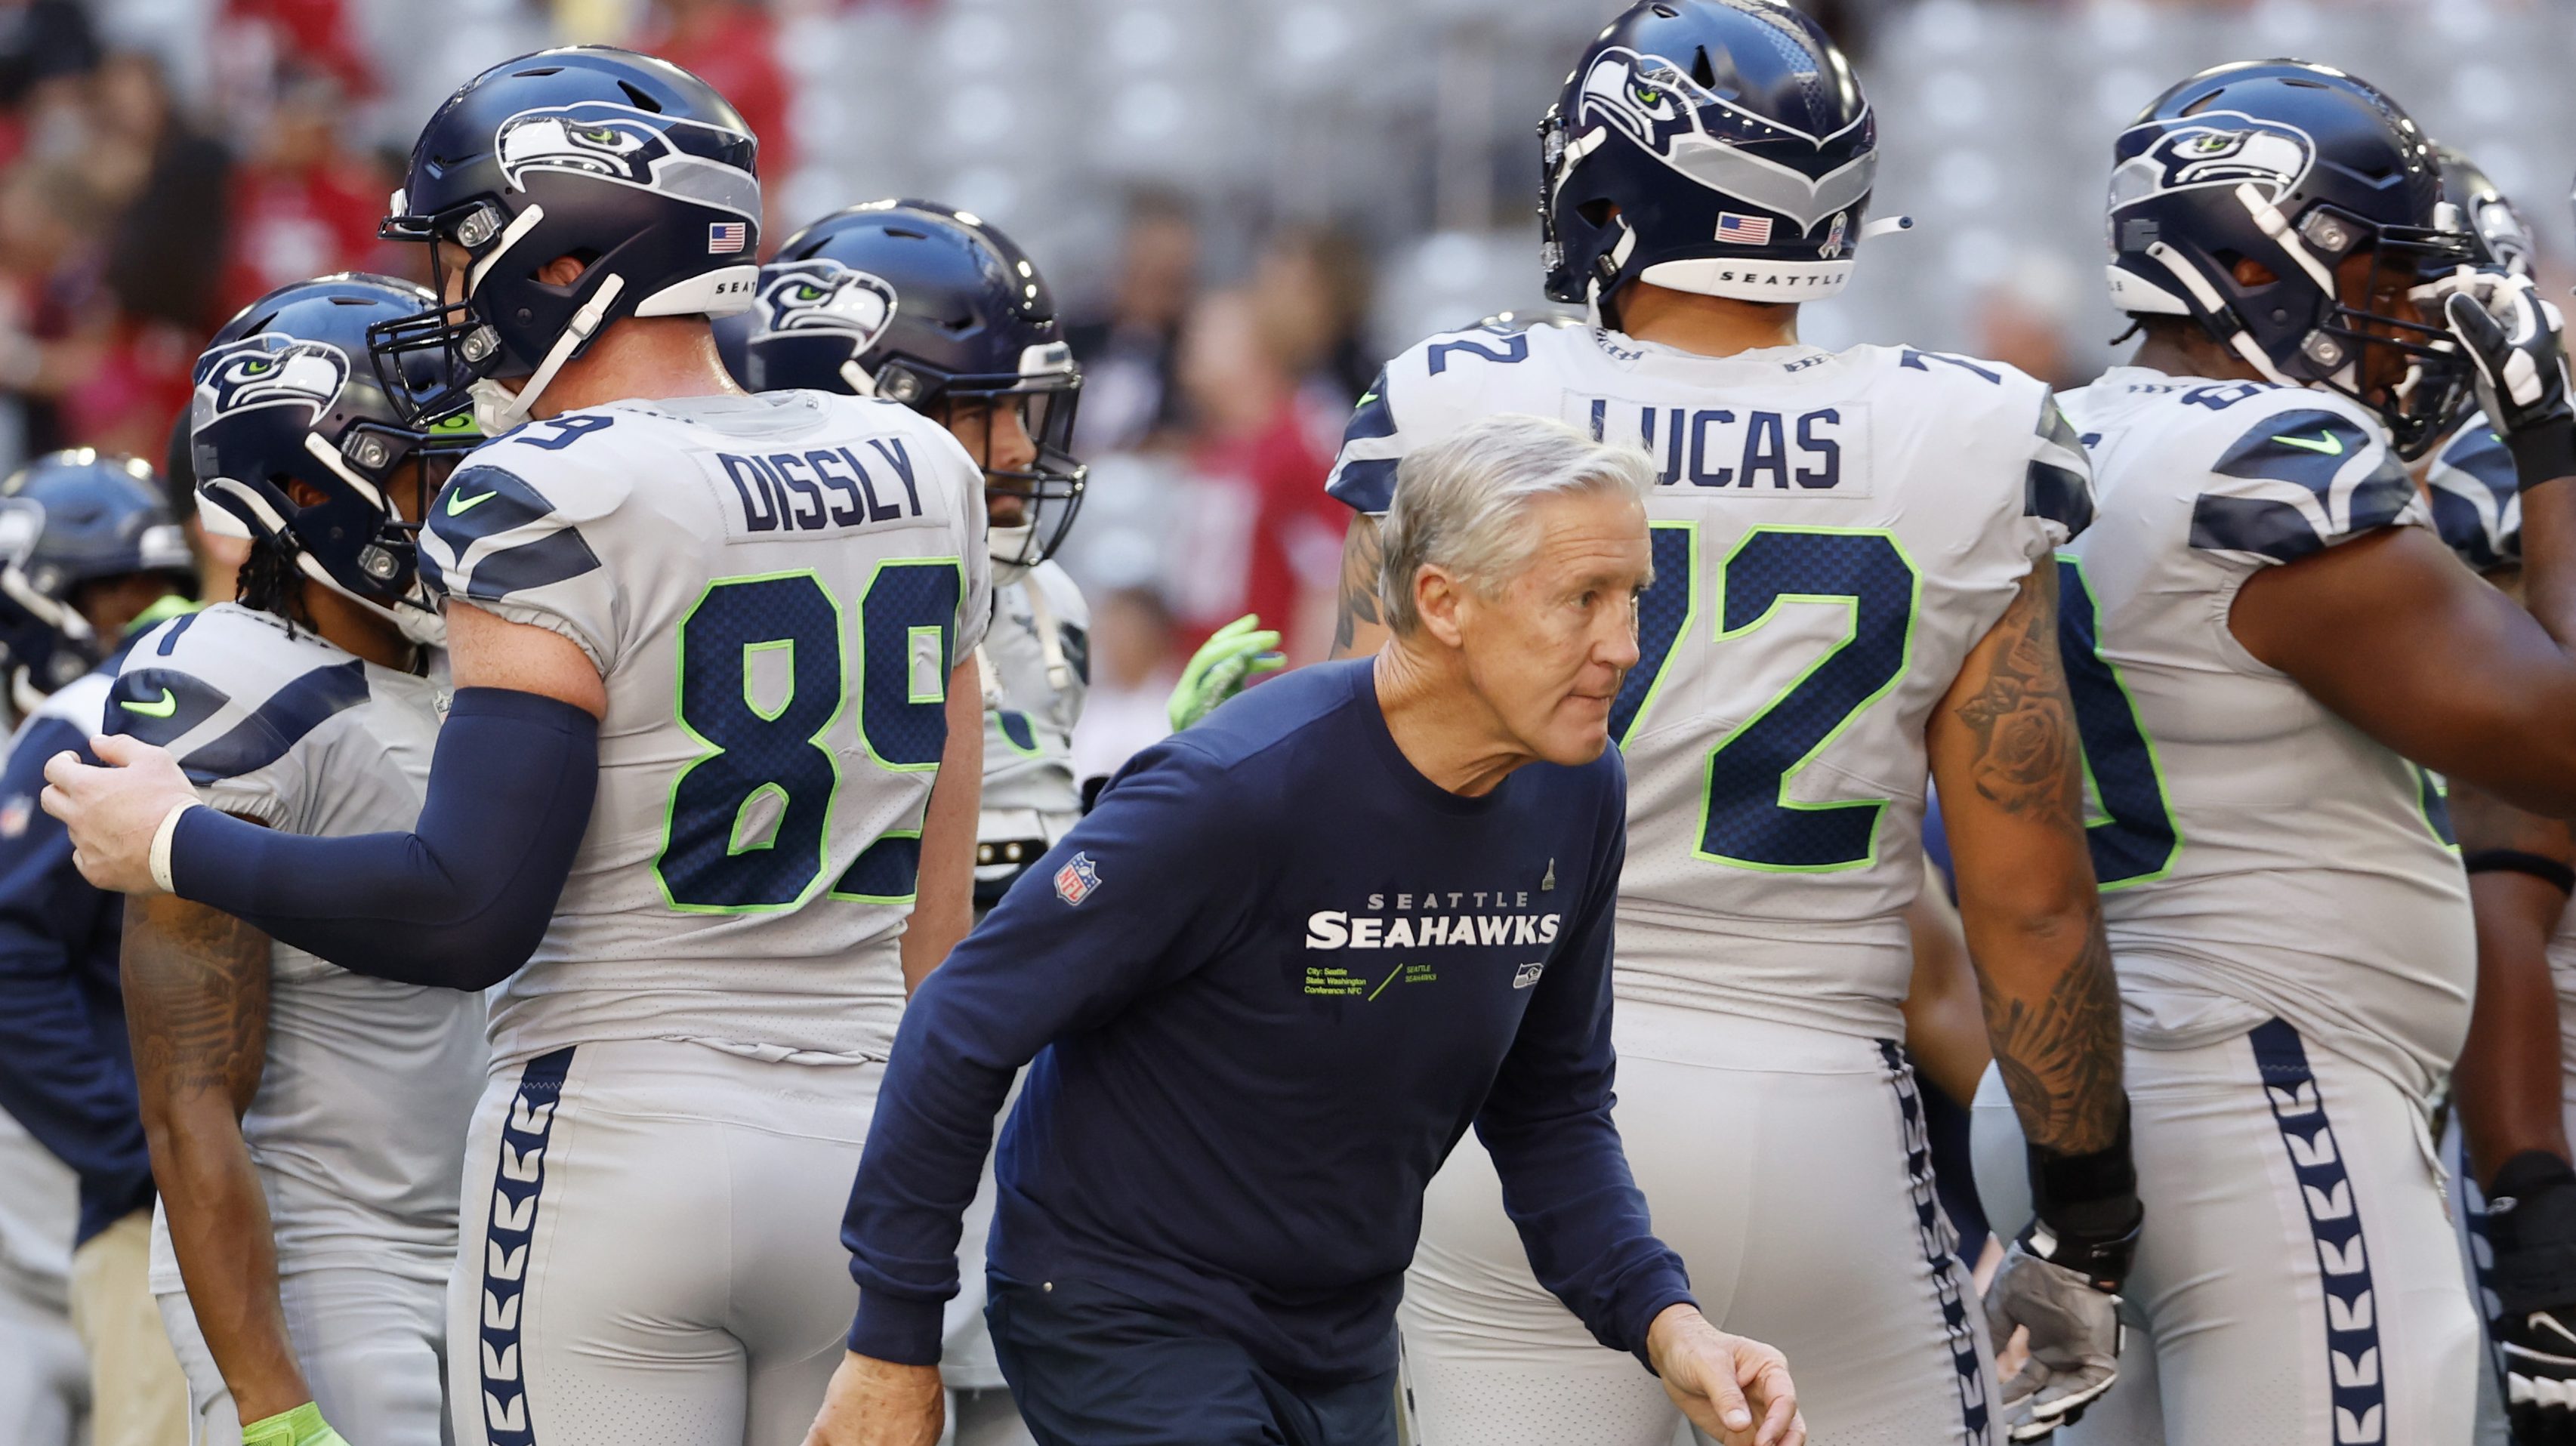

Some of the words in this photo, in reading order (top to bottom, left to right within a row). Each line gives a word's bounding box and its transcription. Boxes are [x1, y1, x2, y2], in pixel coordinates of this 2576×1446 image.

[1720, 271, 1844, 286] SEATTLE
[716, 437, 922, 532] DISSLY
[649, 555, 965, 914] 89
[1367, 892, 1529, 910] SEATTLE
[1306, 911, 1560, 949] SEAHAWKS
[1307, 967, 1322, 976] City:
[1324, 967, 1348, 976] Seattle
[1406, 964, 1431, 973] SEATTLE
[1306, 976, 1325, 985] State:
[1327, 977, 1366, 986] Washington
[1304, 985, 1346, 995] Conference:
[1347, 987, 1362, 995] NFC
